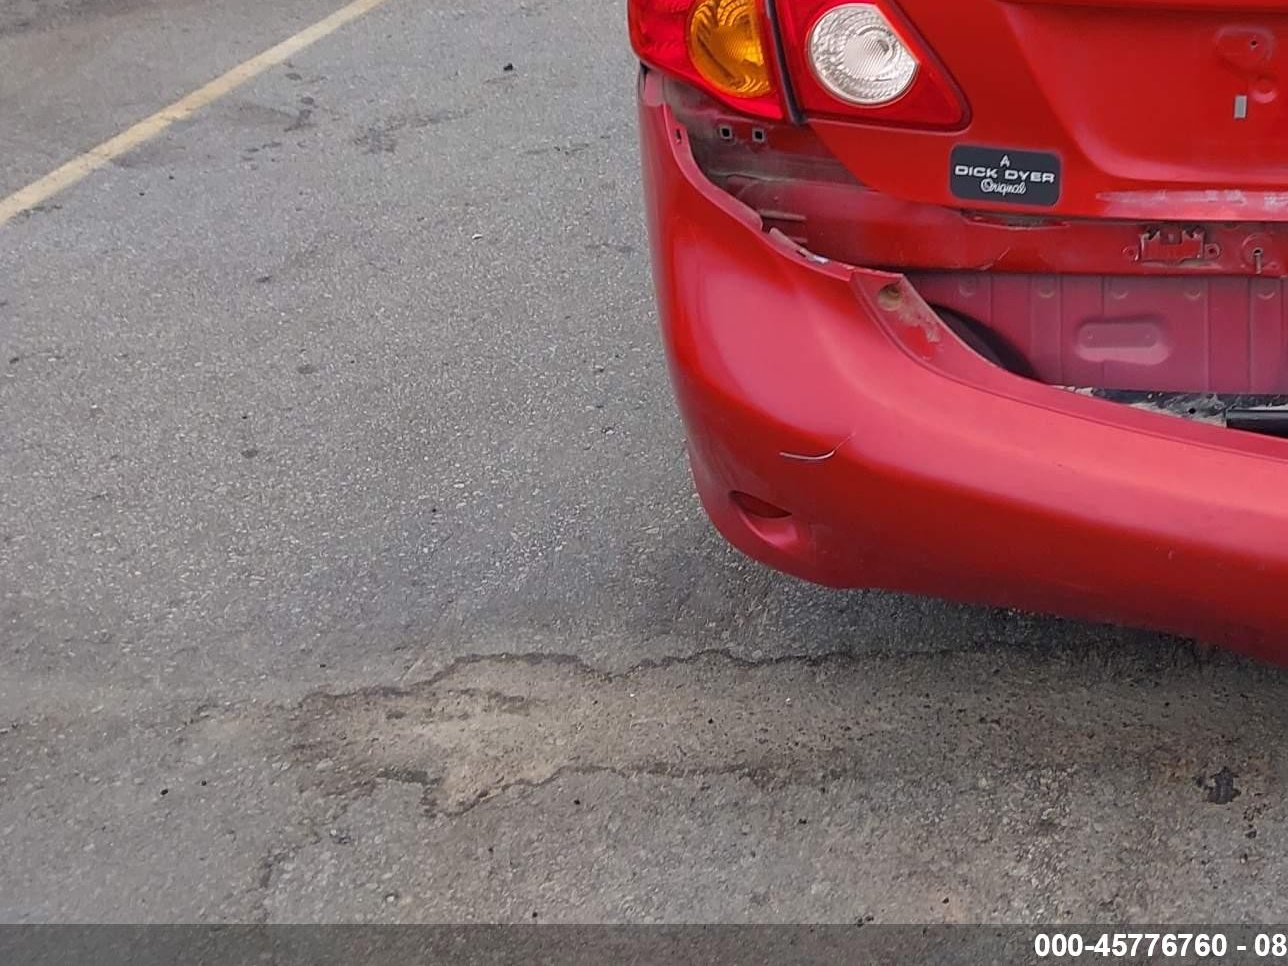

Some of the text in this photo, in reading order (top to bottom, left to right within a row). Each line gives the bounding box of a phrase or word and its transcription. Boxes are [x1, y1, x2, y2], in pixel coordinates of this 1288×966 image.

[1000, 155, 1010, 167] A
[955, 165, 1055, 183] DICK DYER
[980, 178, 1026, 196] Original
